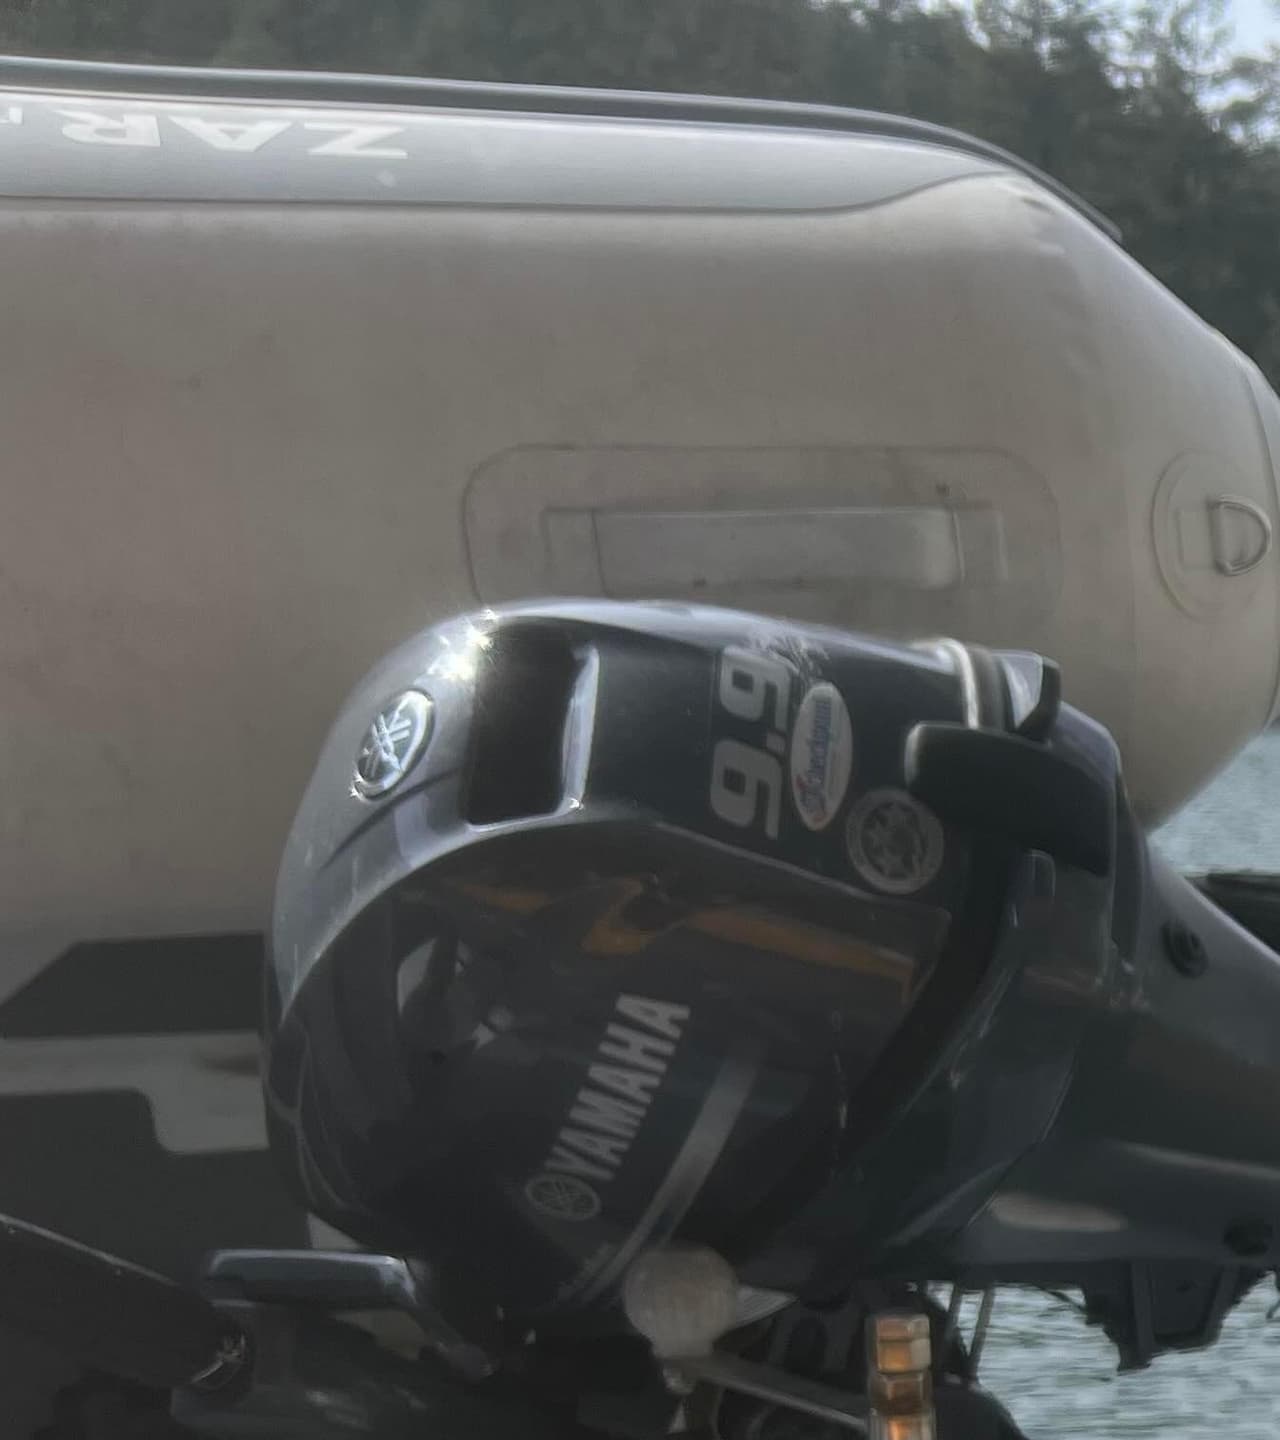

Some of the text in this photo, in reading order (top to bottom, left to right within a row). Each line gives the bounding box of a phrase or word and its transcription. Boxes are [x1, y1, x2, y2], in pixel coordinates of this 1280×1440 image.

[54, 108, 408, 159] ZAR
[710, 645, 793, 840] 9.9
[543, 991, 691, 1182] YAMAHA
